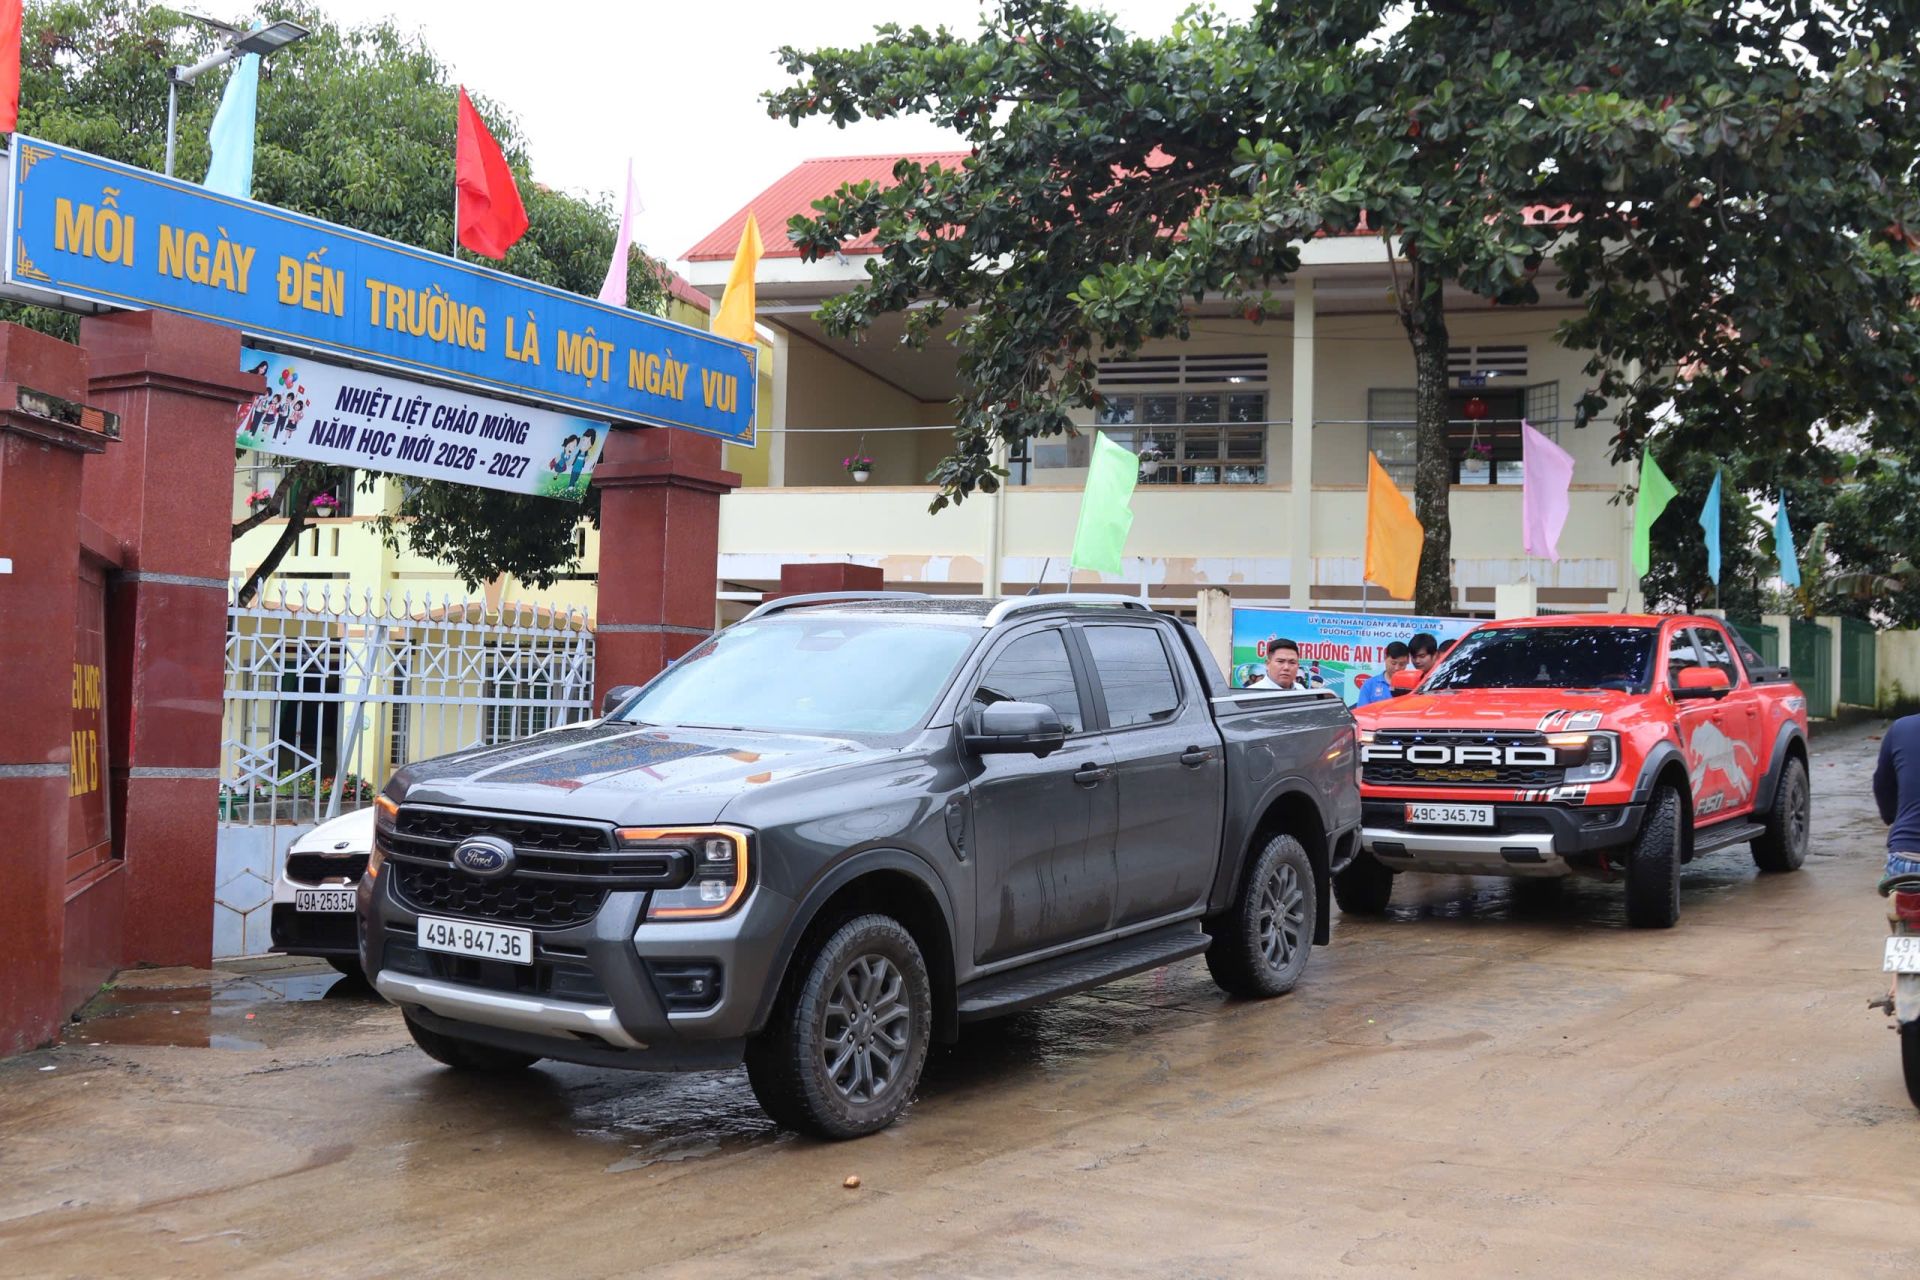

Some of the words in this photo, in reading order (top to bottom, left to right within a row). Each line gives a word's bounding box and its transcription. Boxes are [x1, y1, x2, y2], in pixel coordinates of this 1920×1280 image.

[55, 186, 135, 267] MỖI
[157, 225, 257, 295] NGÀY
[276, 246, 346, 317] ĐẾN
[365, 278, 487, 353] TRƯỜNG
[504, 310, 541, 366] LÀ
[555, 325, 615, 388] MỘT
[628, 348, 690, 401] NGÀY
[701, 368, 738, 414] VUI
[334, 385, 393, 422] NHIỆT
[391, 395, 433, 430] LIỆT
[431, 404, 479, 436] CHÀO
[479, 412, 531, 445] MỪNG
[308, 416, 357, 451] NĂM
[356, 427, 397, 460] HỌC
[396, 433, 436, 464] MỚI
[433, 442, 478, 471] 2026
[487, 452, 531, 479] 2027
[1321, 617, 1338, 625] BAN
[1340, 617, 1364, 626] NHÂN
[1366, 618, 1384, 628] DÂN
[1297, 640, 1351, 662] TRƯỜNG
[1353, 645, 1373, 663] AN
[1361, 745, 1556, 766] FORD
[464, 848, 494, 866] Ford
